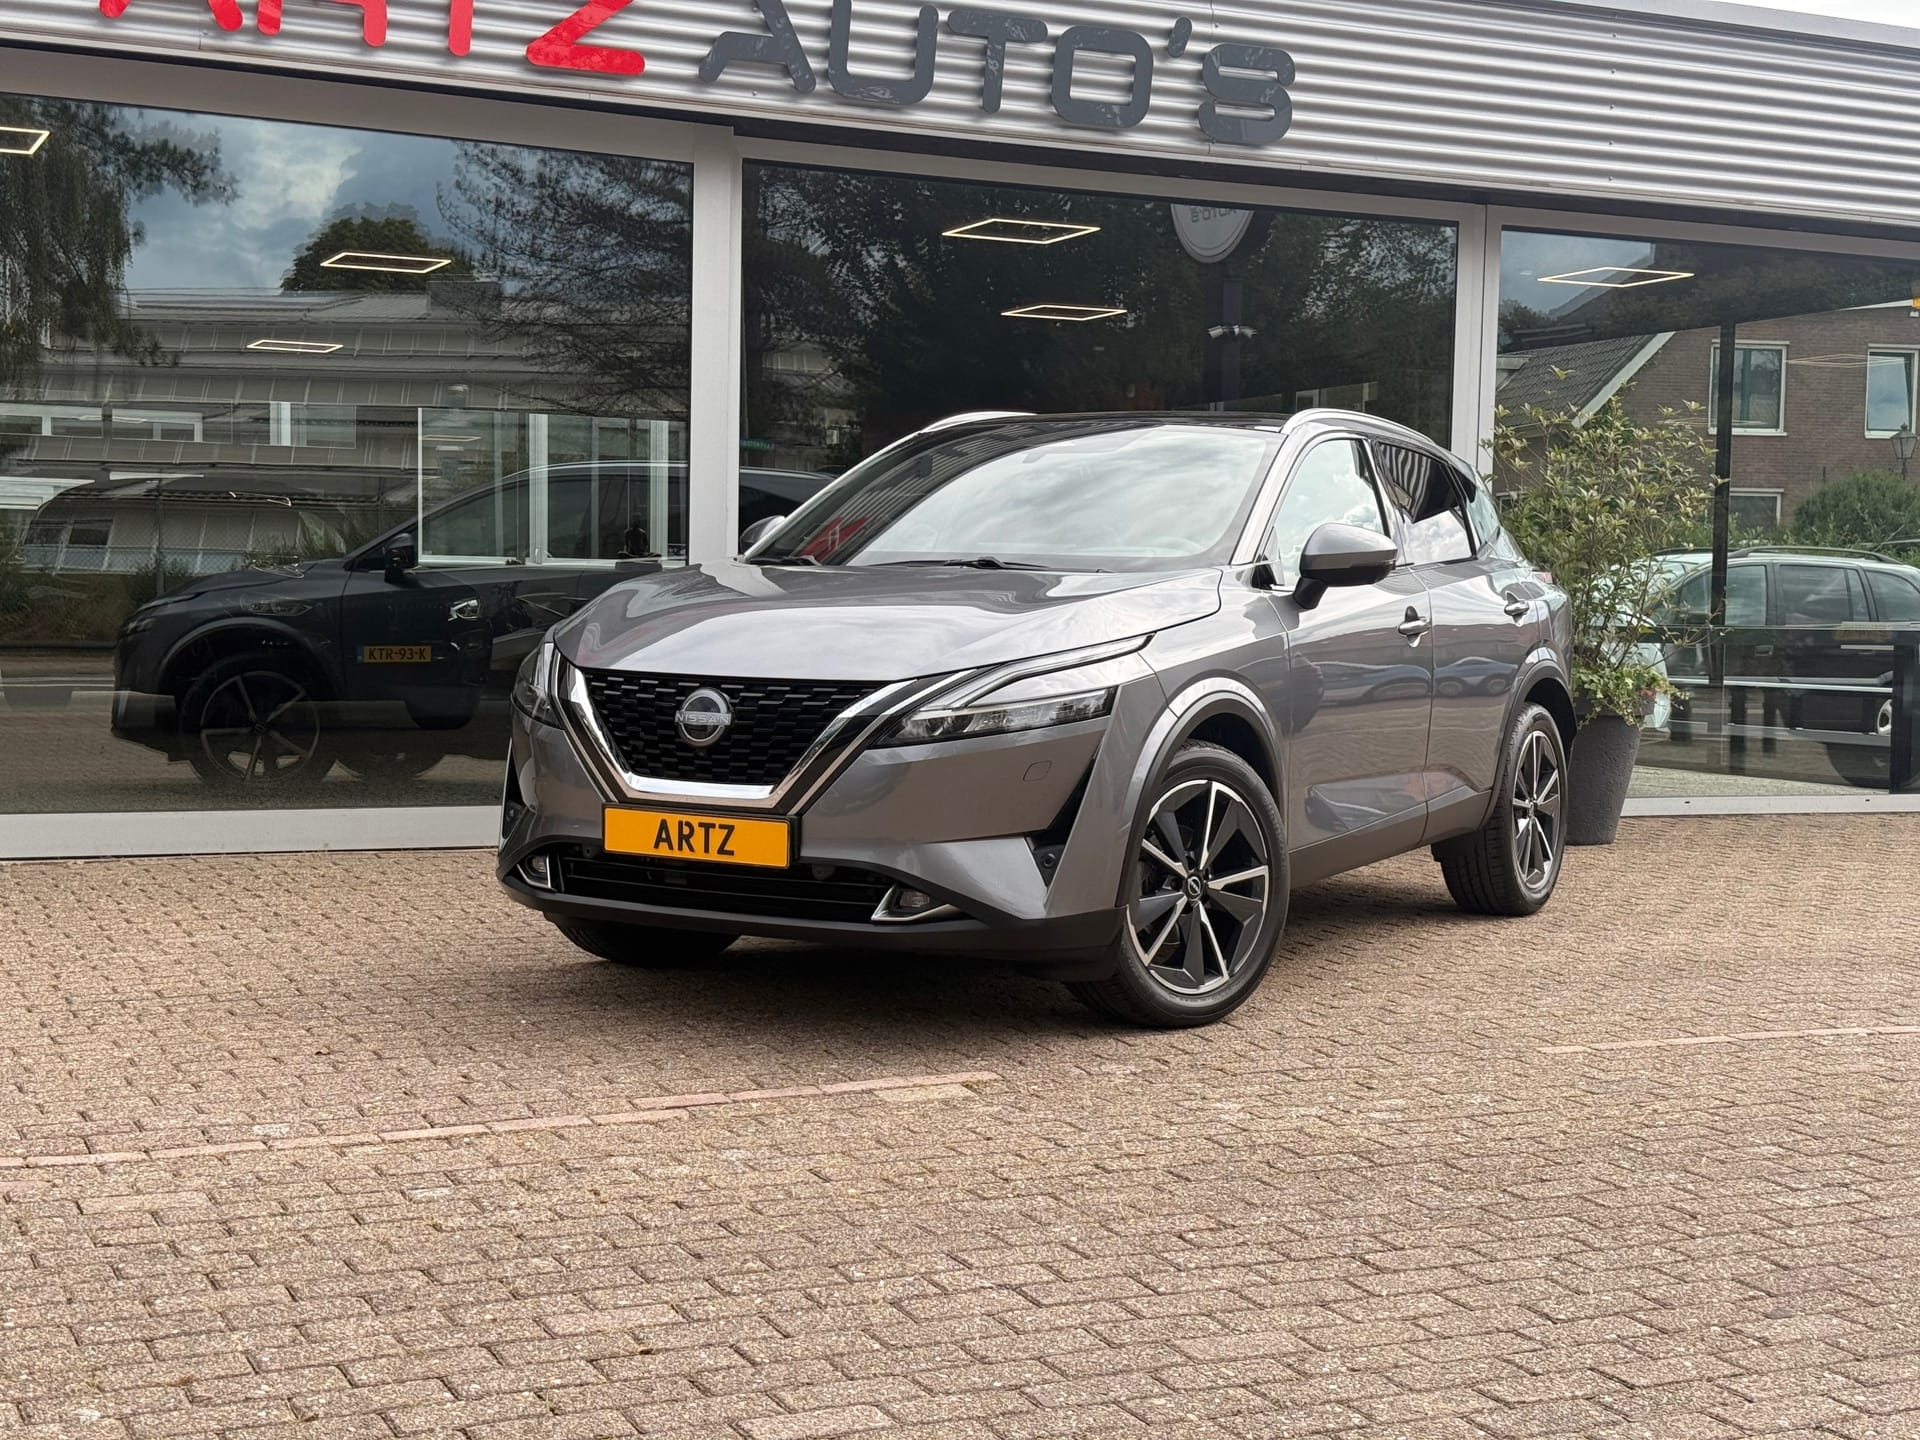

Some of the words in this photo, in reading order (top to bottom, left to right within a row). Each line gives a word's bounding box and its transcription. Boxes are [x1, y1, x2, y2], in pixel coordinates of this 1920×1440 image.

[699, 0, 1296, 146] AUTO'S
[368, 647, 427, 661] KTR-93-K
[675, 711, 731, 724] NISSAN
[653, 818, 736, 857] ARTZ
